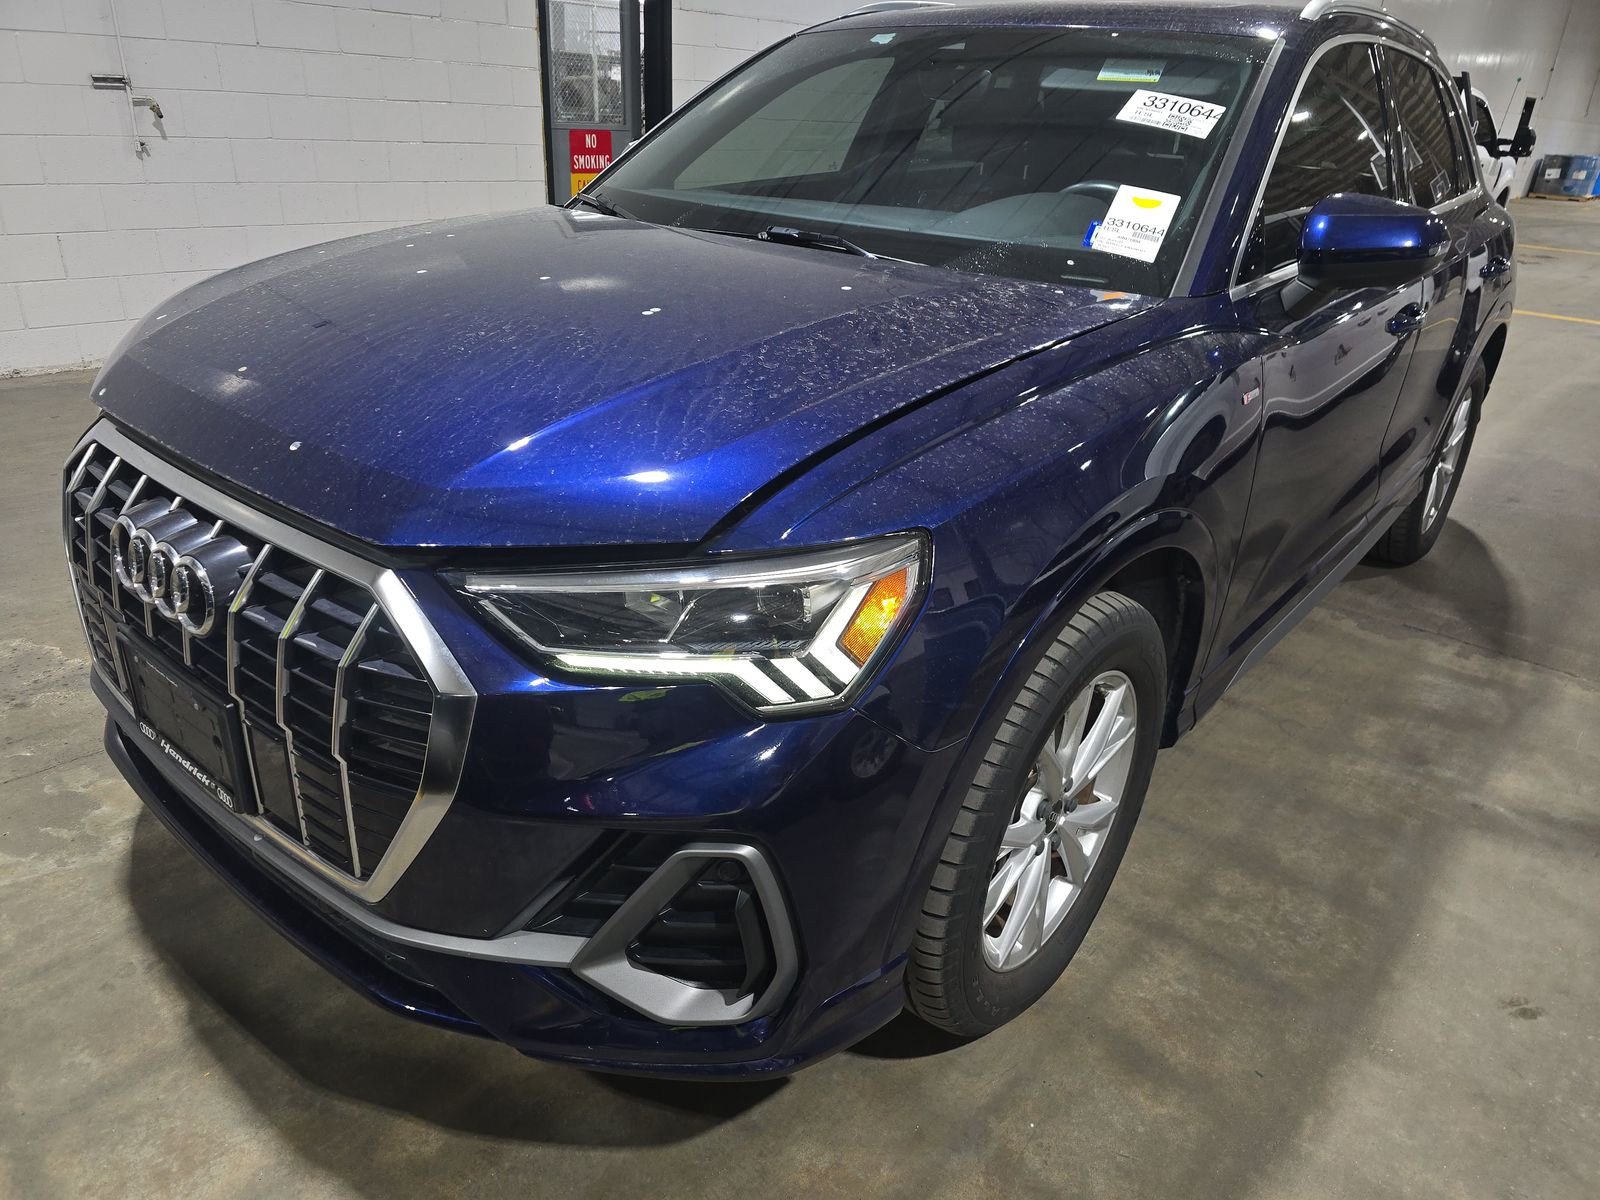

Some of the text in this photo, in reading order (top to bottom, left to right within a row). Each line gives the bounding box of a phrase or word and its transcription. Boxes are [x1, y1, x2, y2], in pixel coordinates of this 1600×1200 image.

[585, 133, 597, 149] NO
[573, 154, 610, 169] SMOKING
[1107, 217, 1165, 237] 3310644
